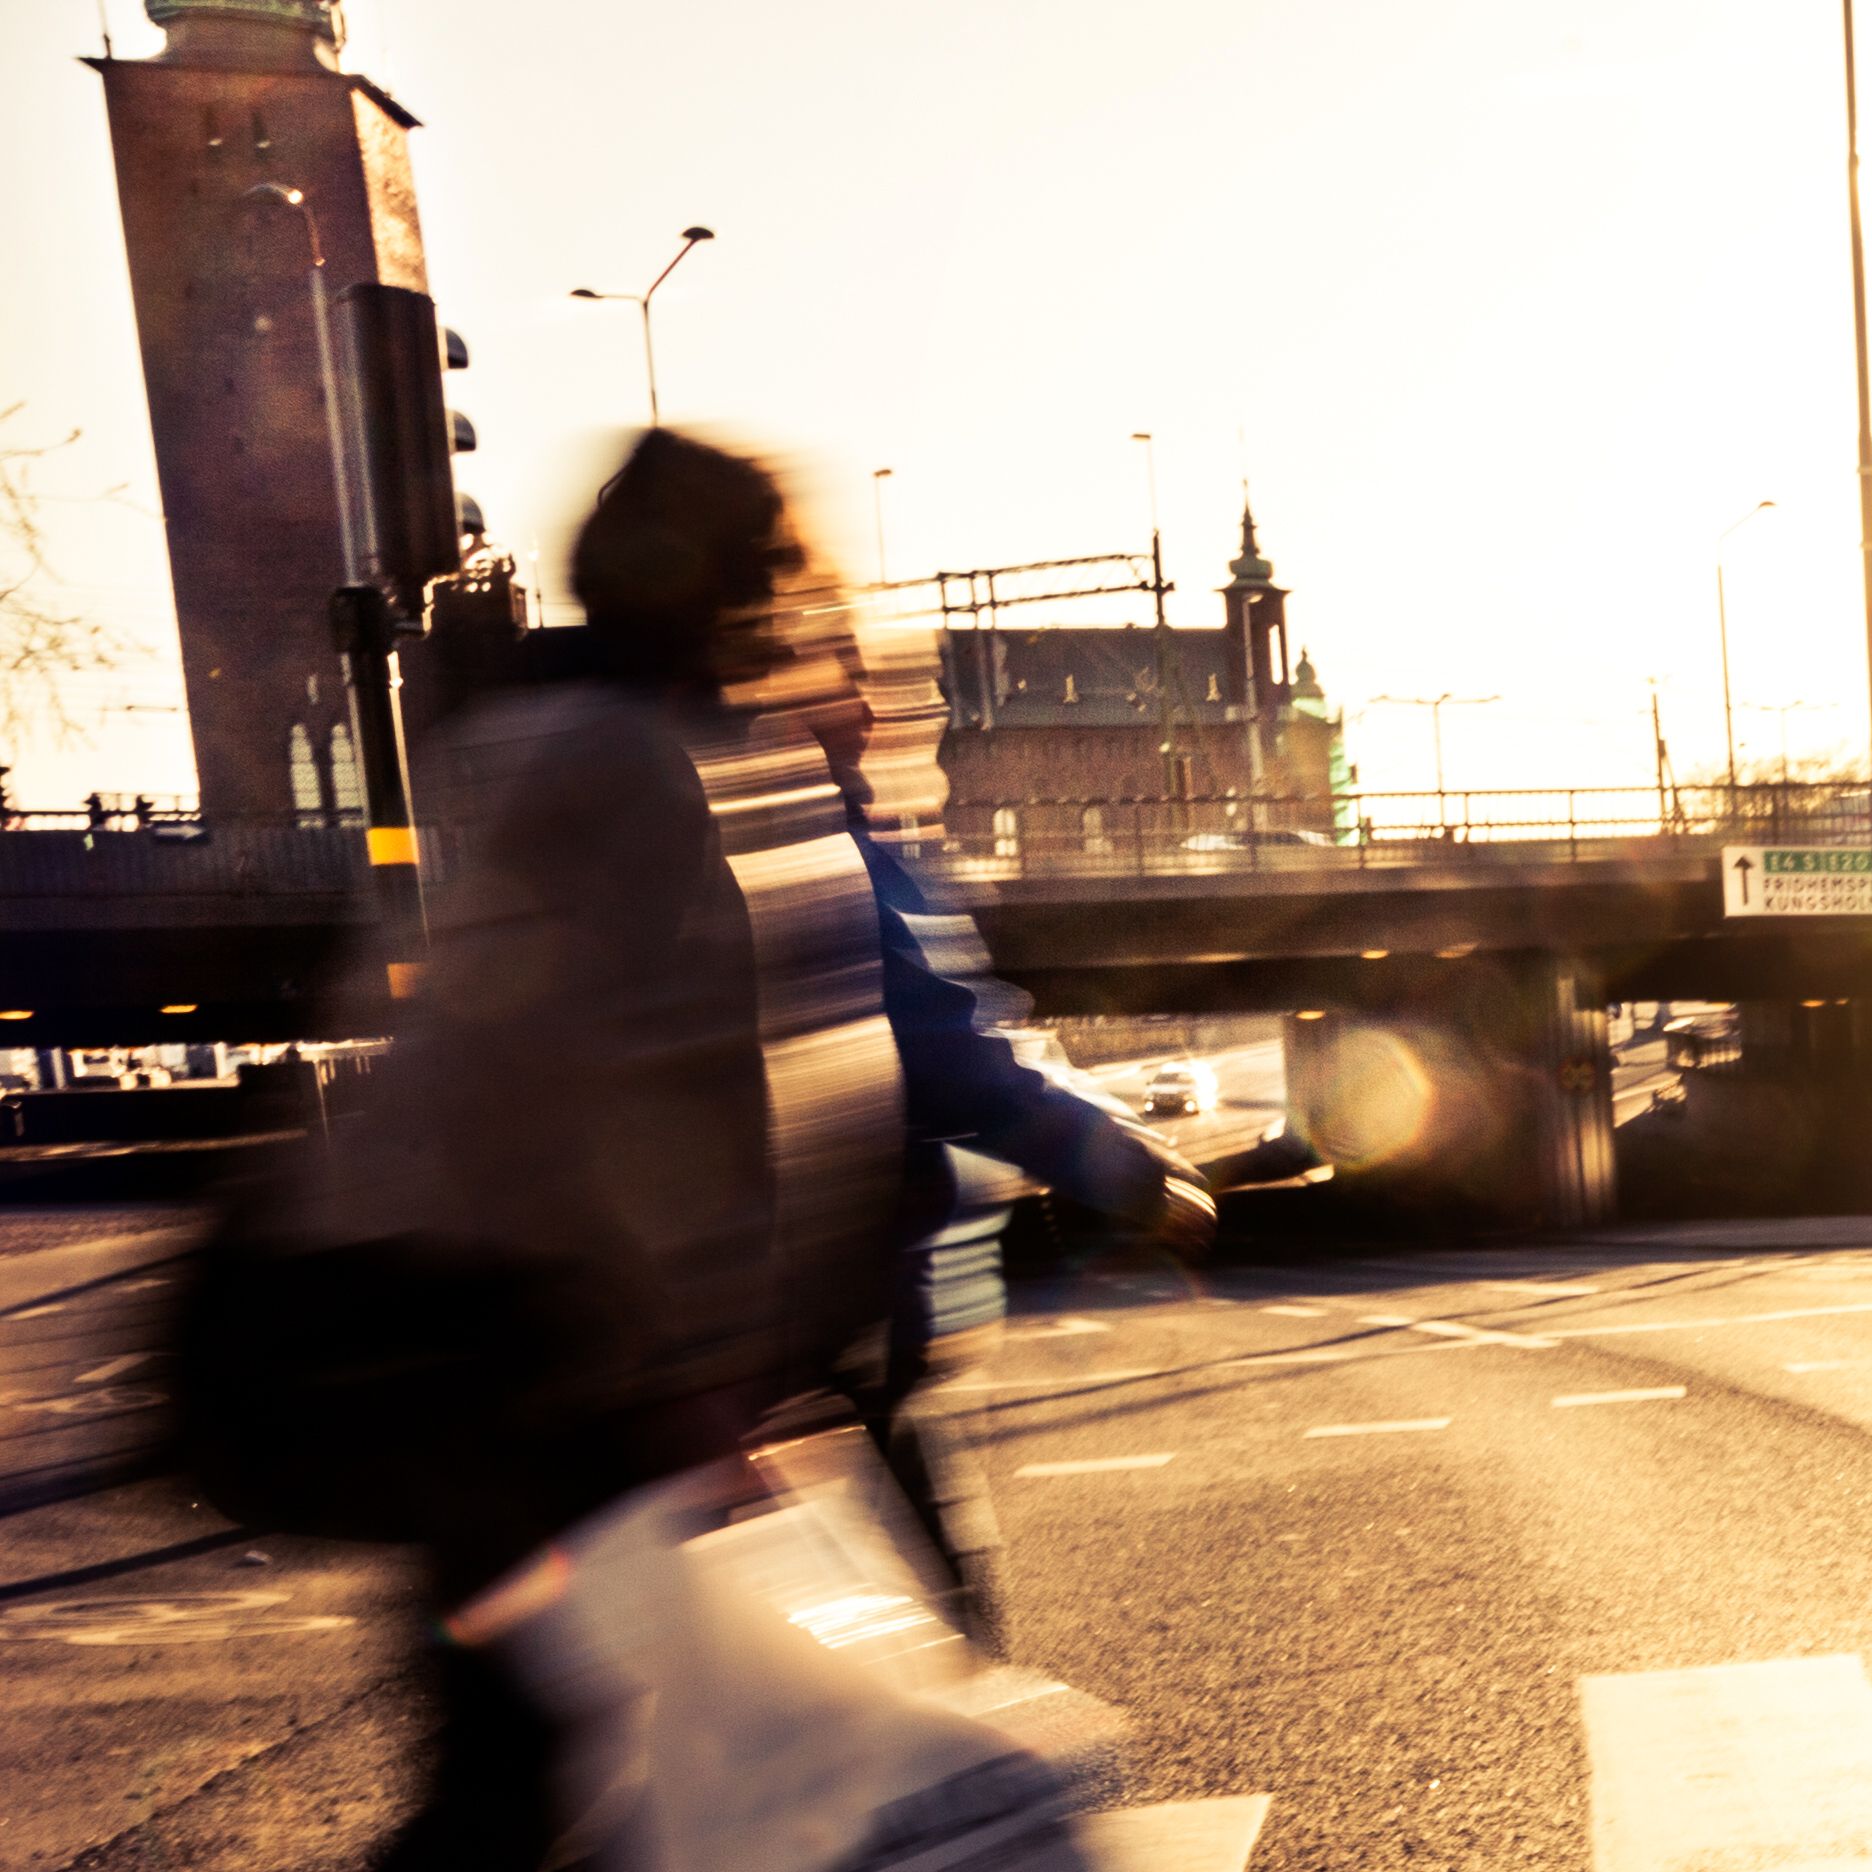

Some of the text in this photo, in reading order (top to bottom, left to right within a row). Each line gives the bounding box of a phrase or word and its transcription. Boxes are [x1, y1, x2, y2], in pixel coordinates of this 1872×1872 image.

[1769, 854, 1870, 871] E4 S E20
